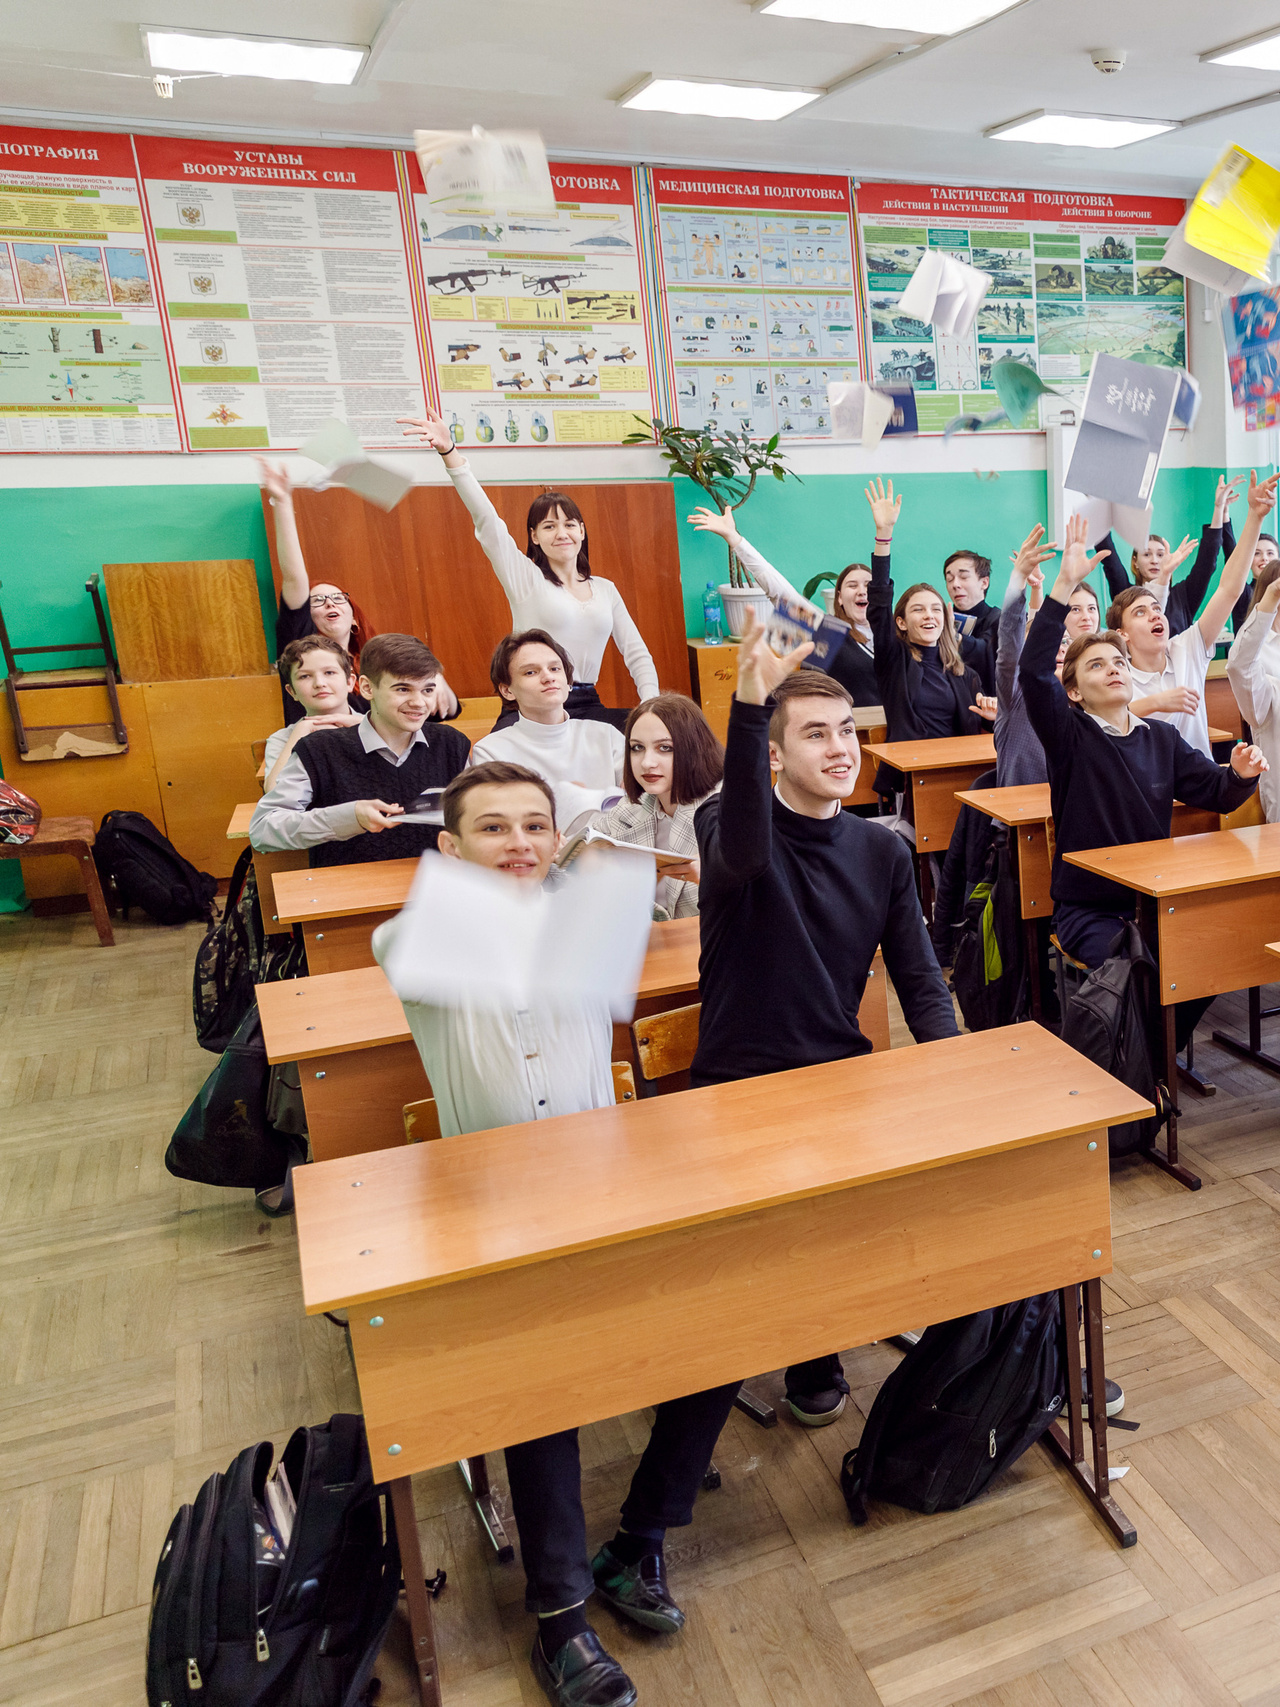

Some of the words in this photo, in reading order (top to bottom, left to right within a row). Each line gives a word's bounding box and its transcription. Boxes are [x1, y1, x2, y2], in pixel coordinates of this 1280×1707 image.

[233, 150, 304, 166] УСТАВЫ
[182, 162, 319, 181] ВООРУЖЕННЫХ
[322, 170, 357, 183] СИЛ
[659, 179, 760, 196] МЕДИЦИНСКАЯ
[763, 186, 845, 200] ПОДГОТОВКА
[930, 188, 1025, 203] ТАКТИЧЕСКАЯ
[1033, 192, 1114, 207] ПОДГОТОВКА
[882, 199, 931, 210] ДЕЙСТВИЯ
[933, 202, 940, 210] В
[942, 203, 1009, 214] НАСТУПЛЕНИИ
[1061, 207, 1105, 217] ДЕЙСТВИЯ
[1114, 210, 1152, 219] ОБОРОНЕ
